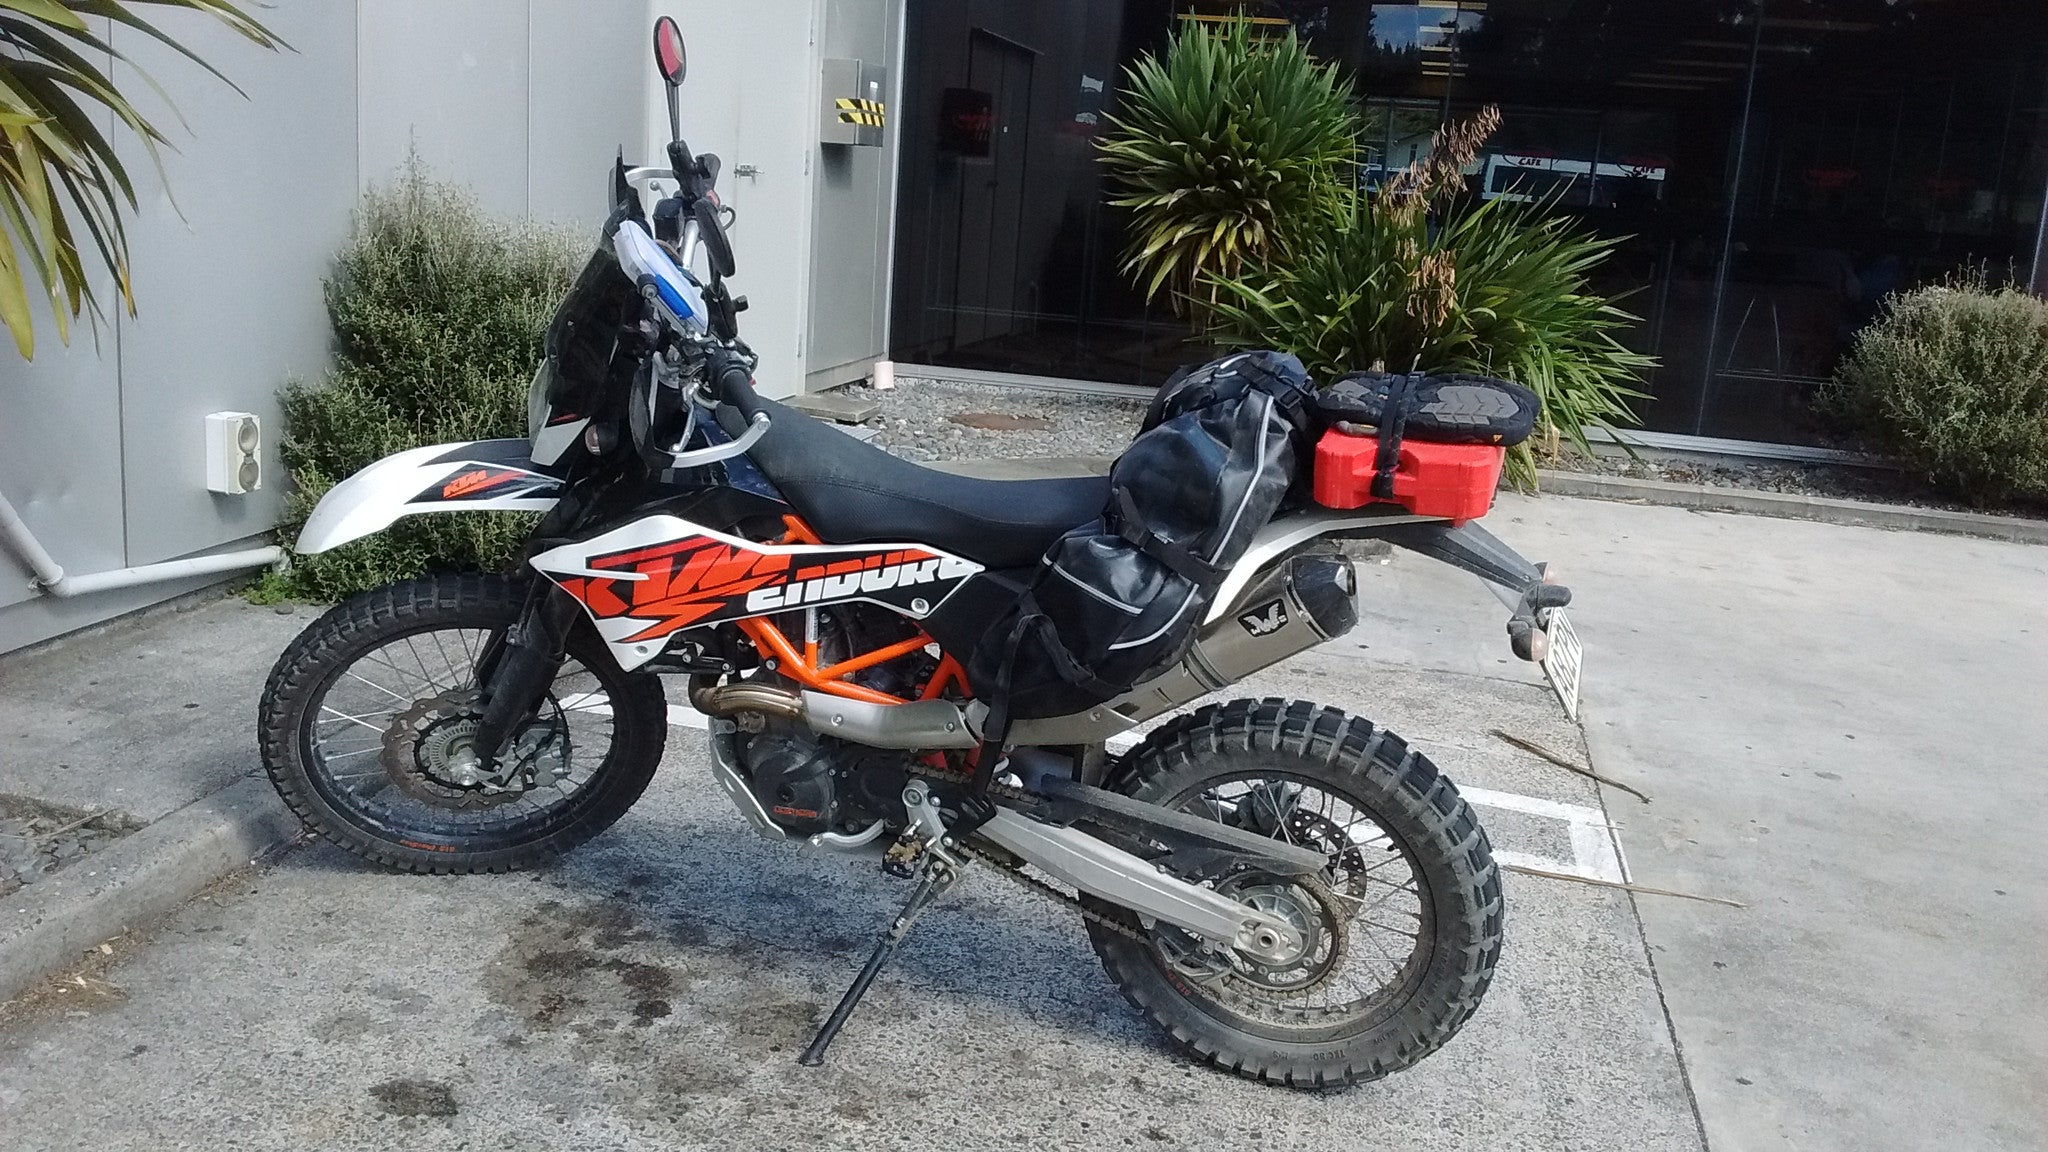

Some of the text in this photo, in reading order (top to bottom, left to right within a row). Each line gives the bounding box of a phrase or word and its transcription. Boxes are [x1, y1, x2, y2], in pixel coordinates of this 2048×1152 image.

[1517, 157, 1542, 168] CAFE
[442, 469, 487, 498] KTM
[562, 536, 791, 617] KTM
[746, 548, 968, 612] ENDURO
[1551, 609, 1581, 706] A8ZPN
